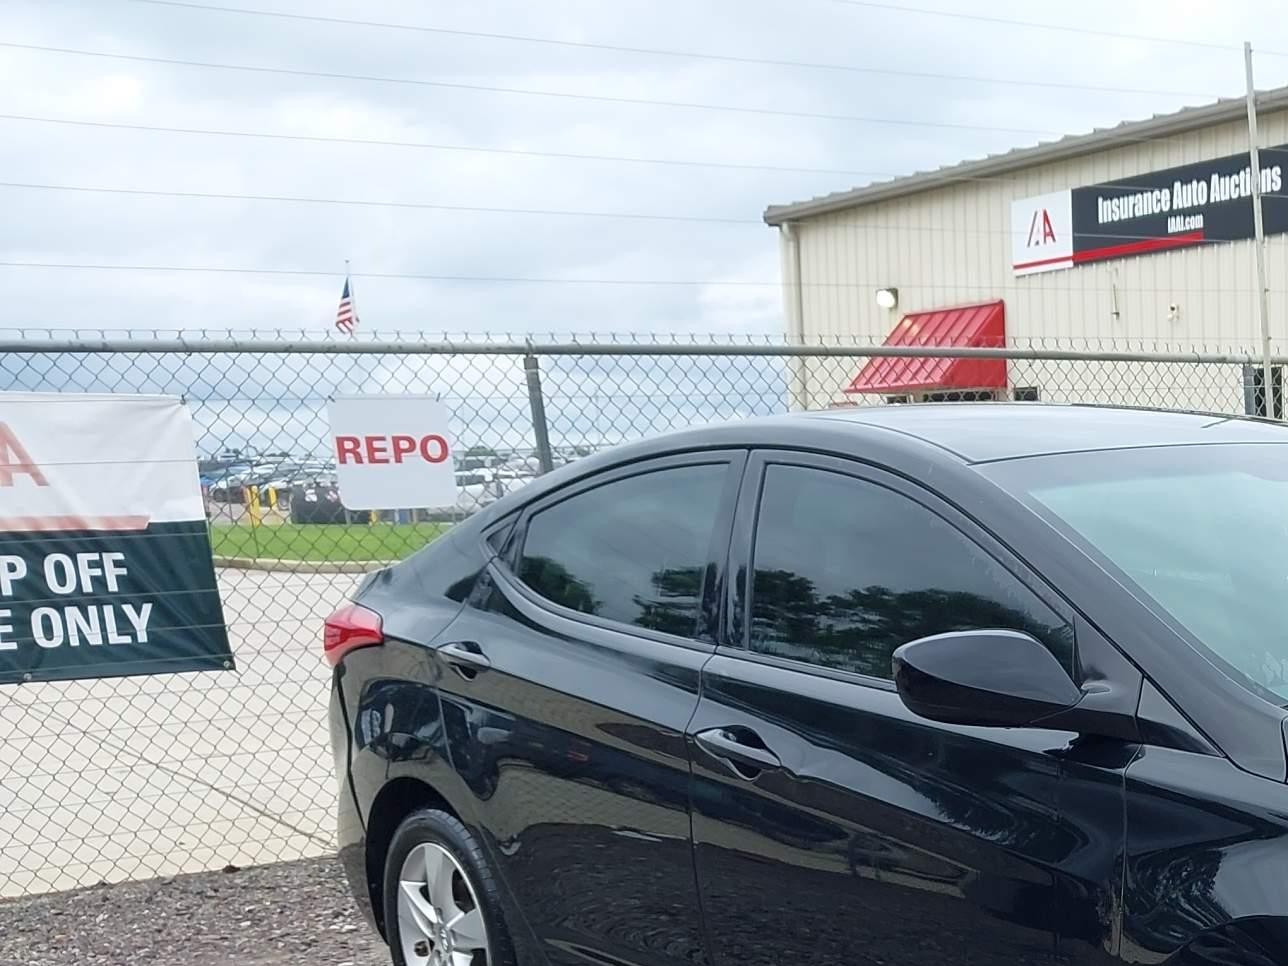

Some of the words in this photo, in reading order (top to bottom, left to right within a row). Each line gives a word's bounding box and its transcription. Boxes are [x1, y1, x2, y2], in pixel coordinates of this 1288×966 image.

[1097, 188, 1170, 224] Insurance
[1172, 179, 1208, 210] Auto
[1210, 165, 1282, 203] Auctins
[1167, 213, 1204, 233] IAAI.com
[335, 434, 449, 465] REPO
[43, 552, 128, 595] OFF
[31, 602, 153, 648] ONLY
